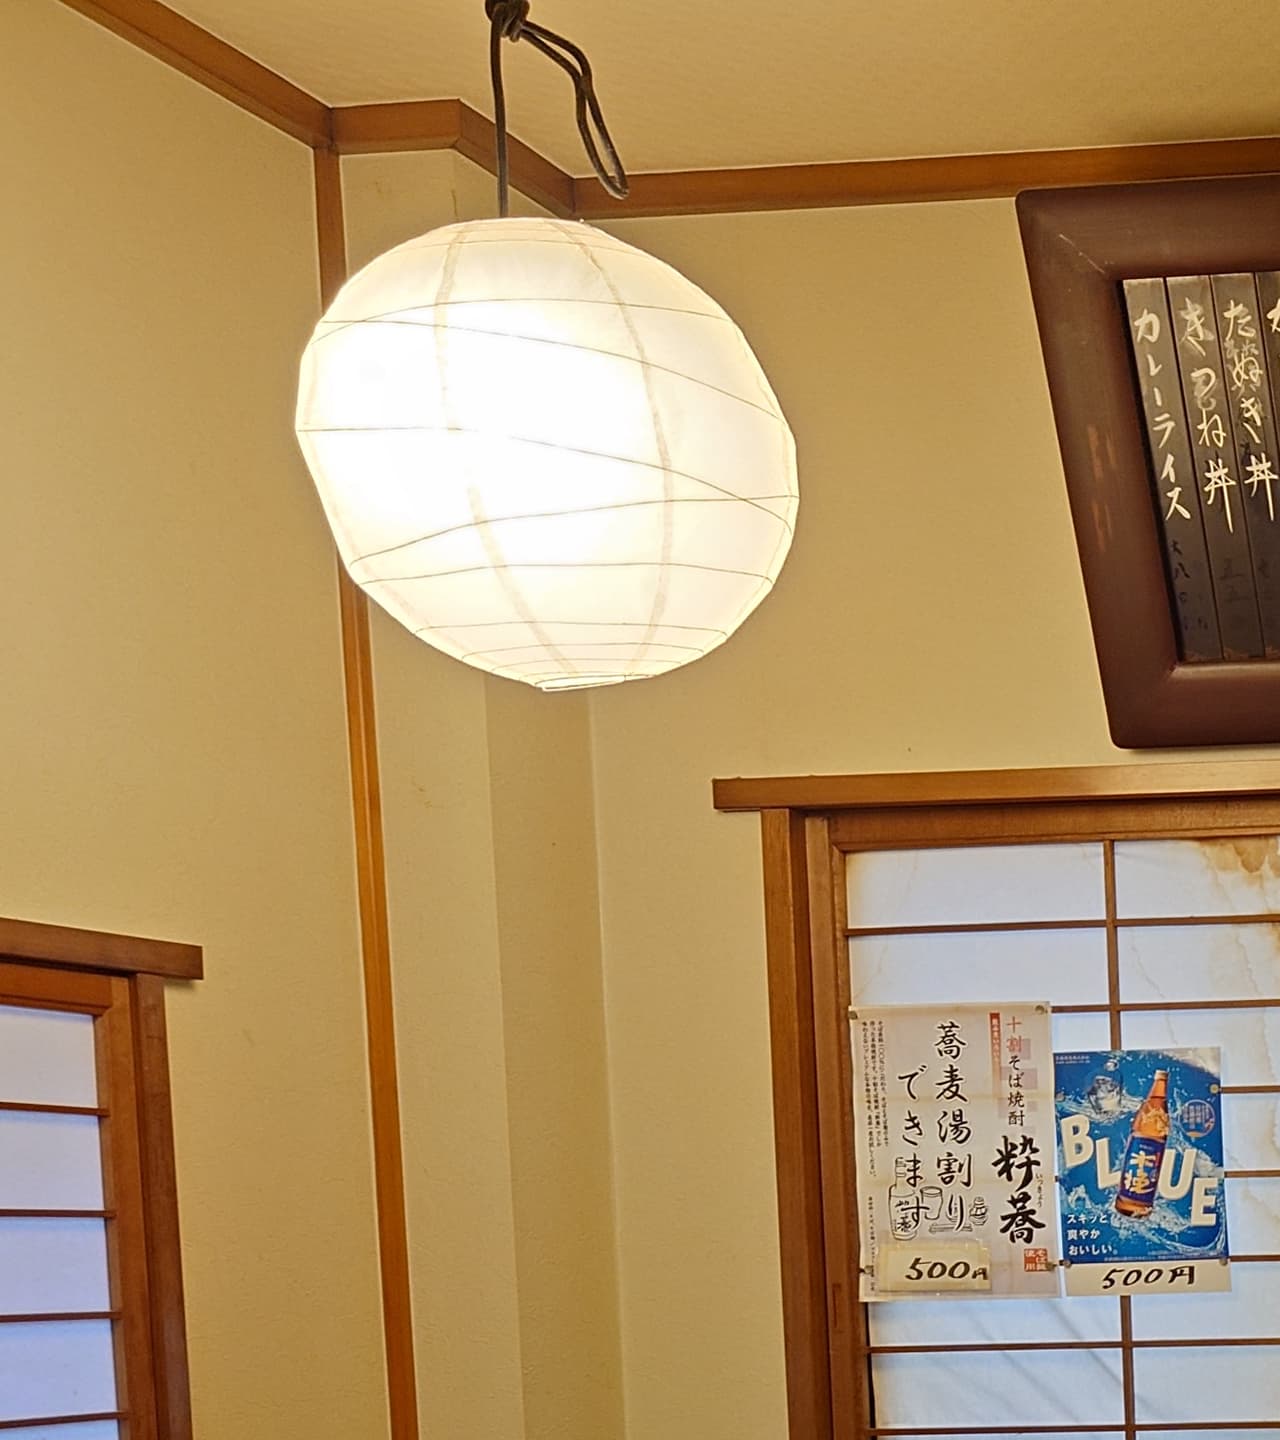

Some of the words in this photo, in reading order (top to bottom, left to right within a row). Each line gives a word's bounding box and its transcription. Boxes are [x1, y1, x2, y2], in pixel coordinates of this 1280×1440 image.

[1134, 309, 1192, 521] カレーライス
[934, 1020, 973, 1232] 蕎麦湯割り
[1006, 1016, 1026, 1128] 十割そば焼酎
[897, 1064, 931, 1232] できます
[1066, 1213, 1108, 1226] スキッと
[1066, 1228, 1101, 1241] 爽やか
[1101, 1264, 1196, 1290] 500円
